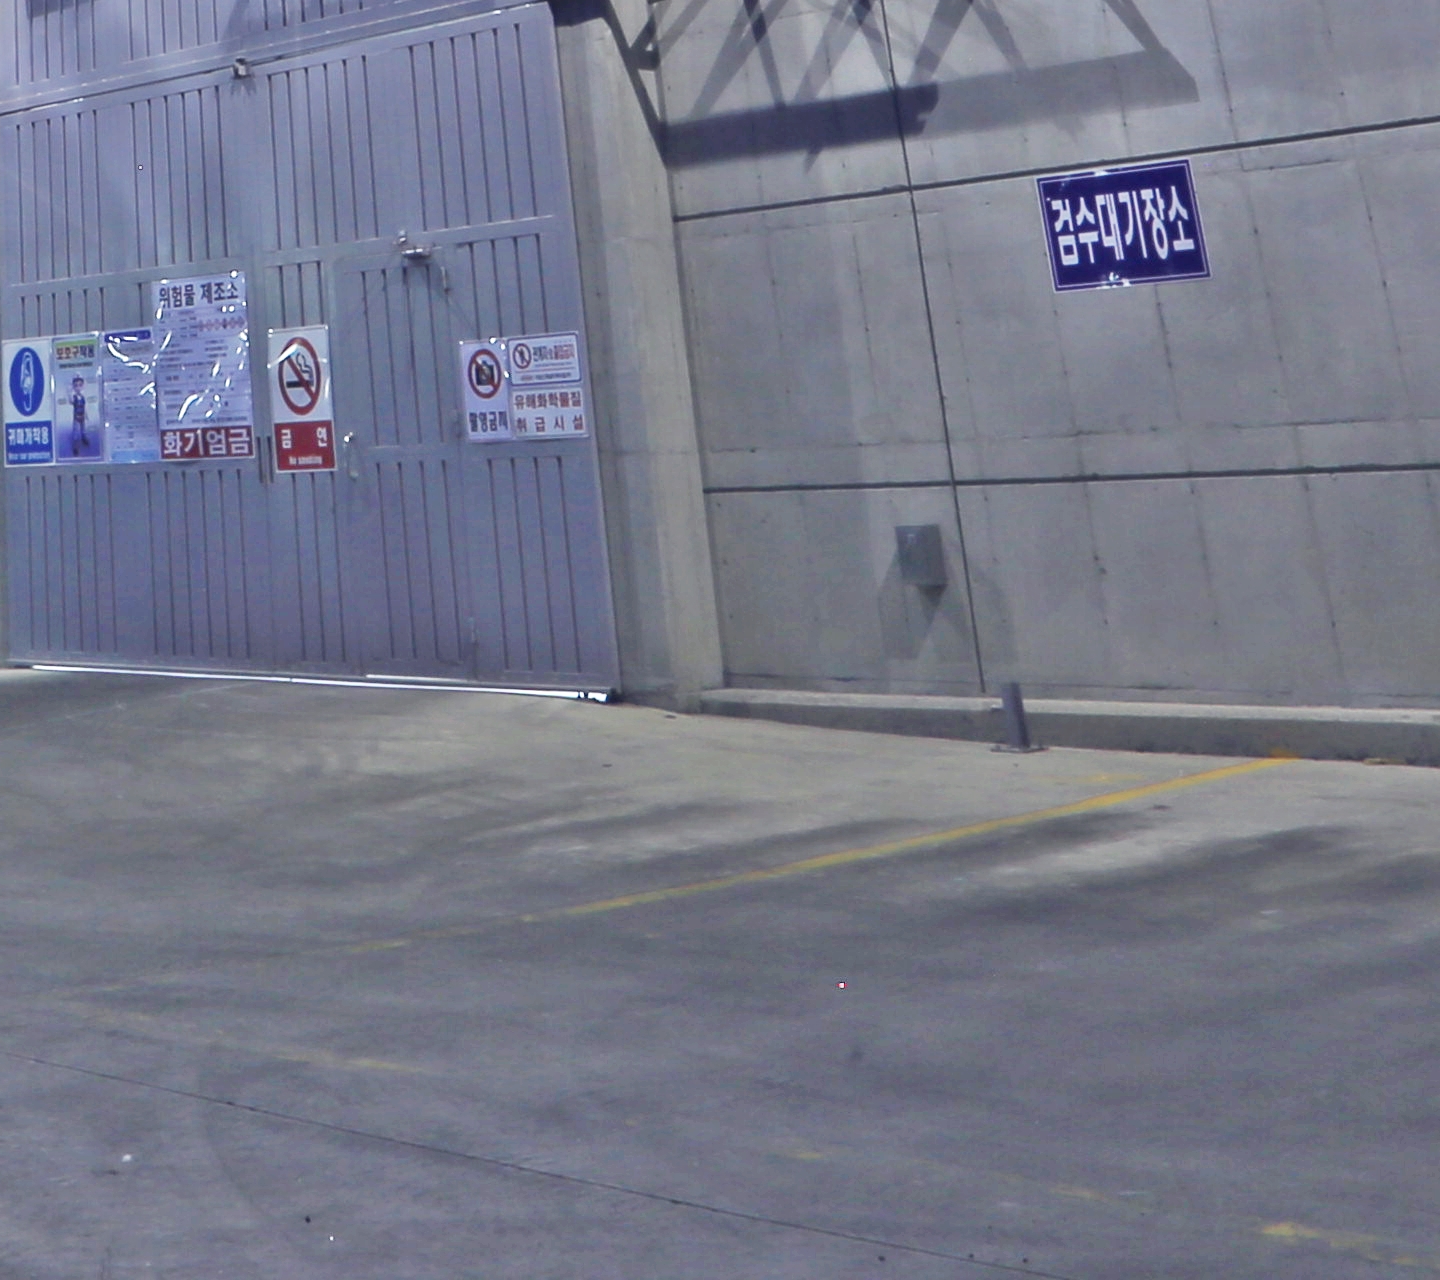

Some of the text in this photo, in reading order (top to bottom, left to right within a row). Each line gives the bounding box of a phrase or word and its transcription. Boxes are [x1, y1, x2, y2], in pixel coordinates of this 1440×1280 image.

[1051, 185, 1195, 266] 검수대기장소
[159, 281, 239, 309] 위험물 제조소
[514, 391, 582, 410] 유해화학물질
[163, 428, 250, 457] 화기엄금
